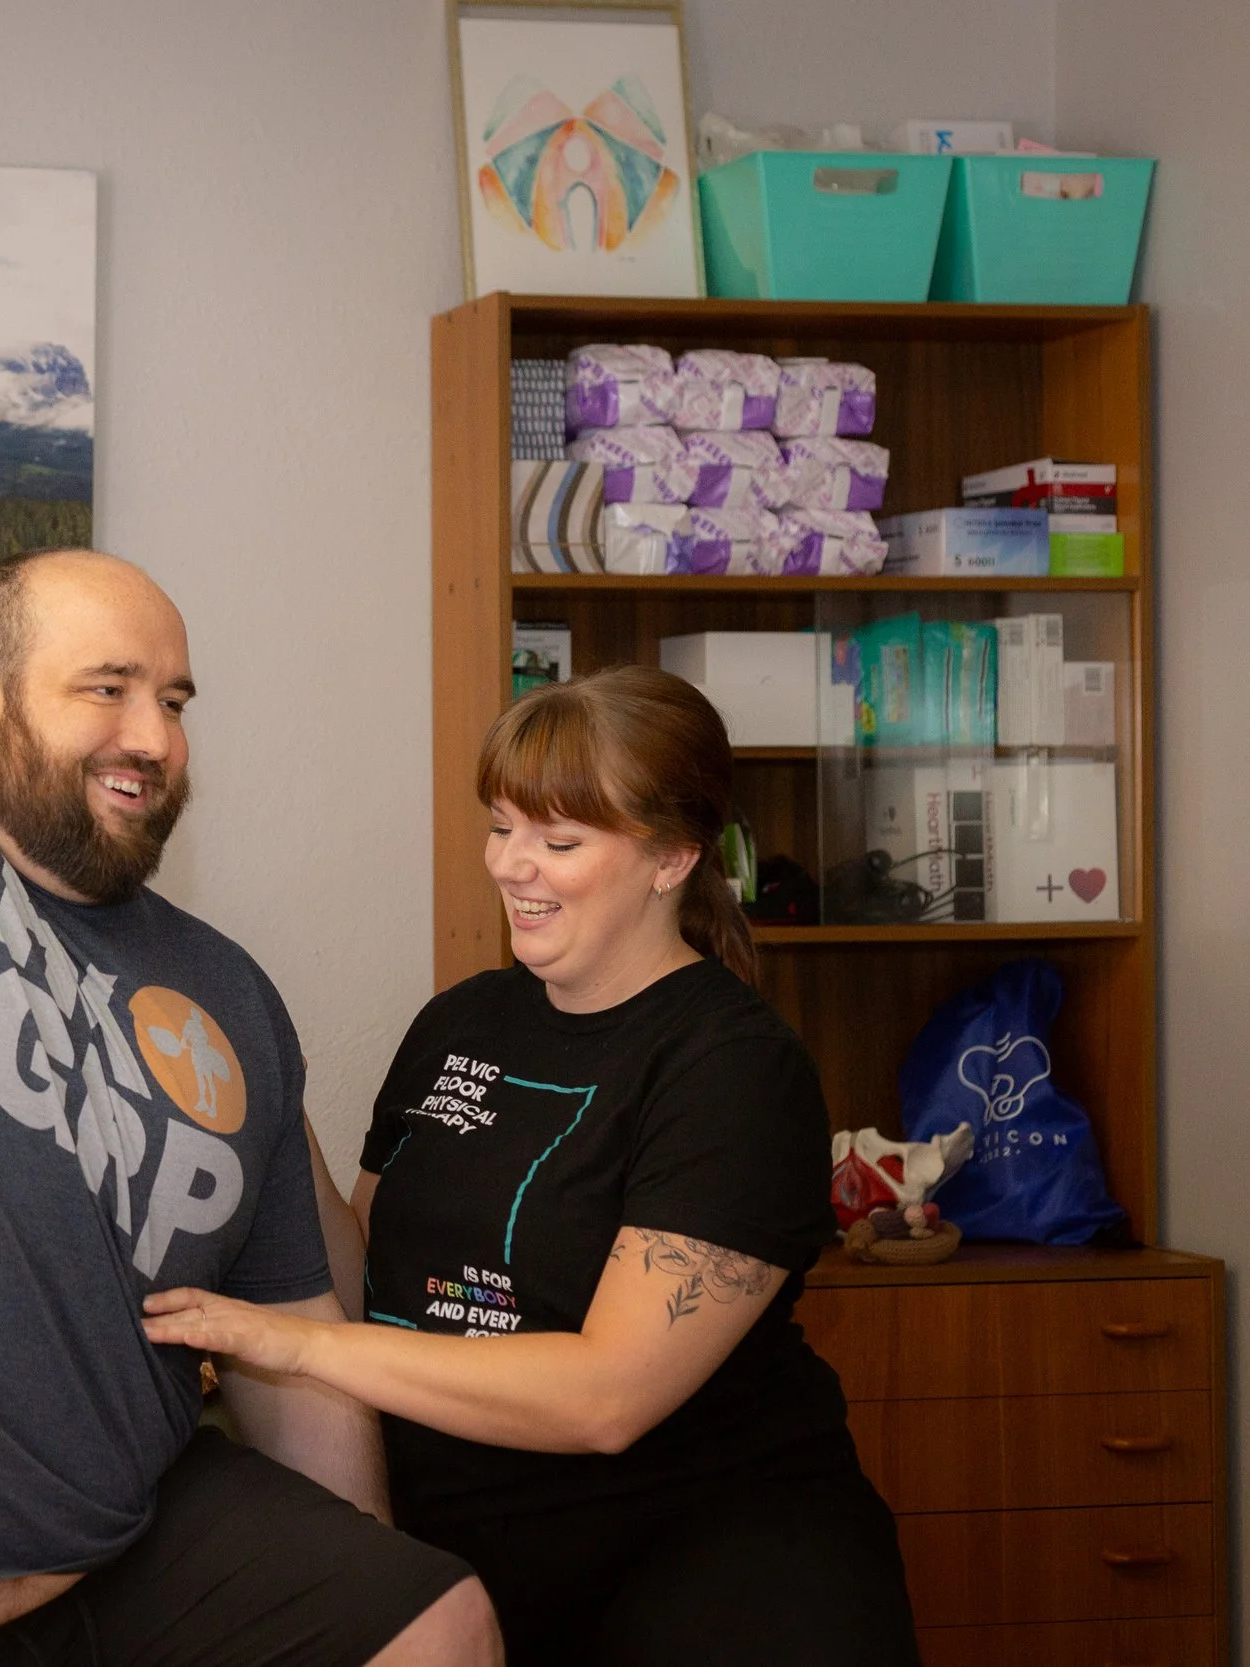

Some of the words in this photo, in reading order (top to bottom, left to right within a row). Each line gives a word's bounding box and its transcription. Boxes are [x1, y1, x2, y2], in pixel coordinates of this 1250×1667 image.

[443, 1053, 501, 1082] PELVIC
[433, 1075, 488, 1102] FLOOR
[420, 1095, 498, 1126] PHYSICAL
[426, 1276, 517, 1308] EVERYBODY
[463, 1265, 480, 1283] IS
[481, 1269, 514, 1292] FOR
[425, 1300, 465, 1320] AND
[467, 1306, 522, 1331] EVERY
